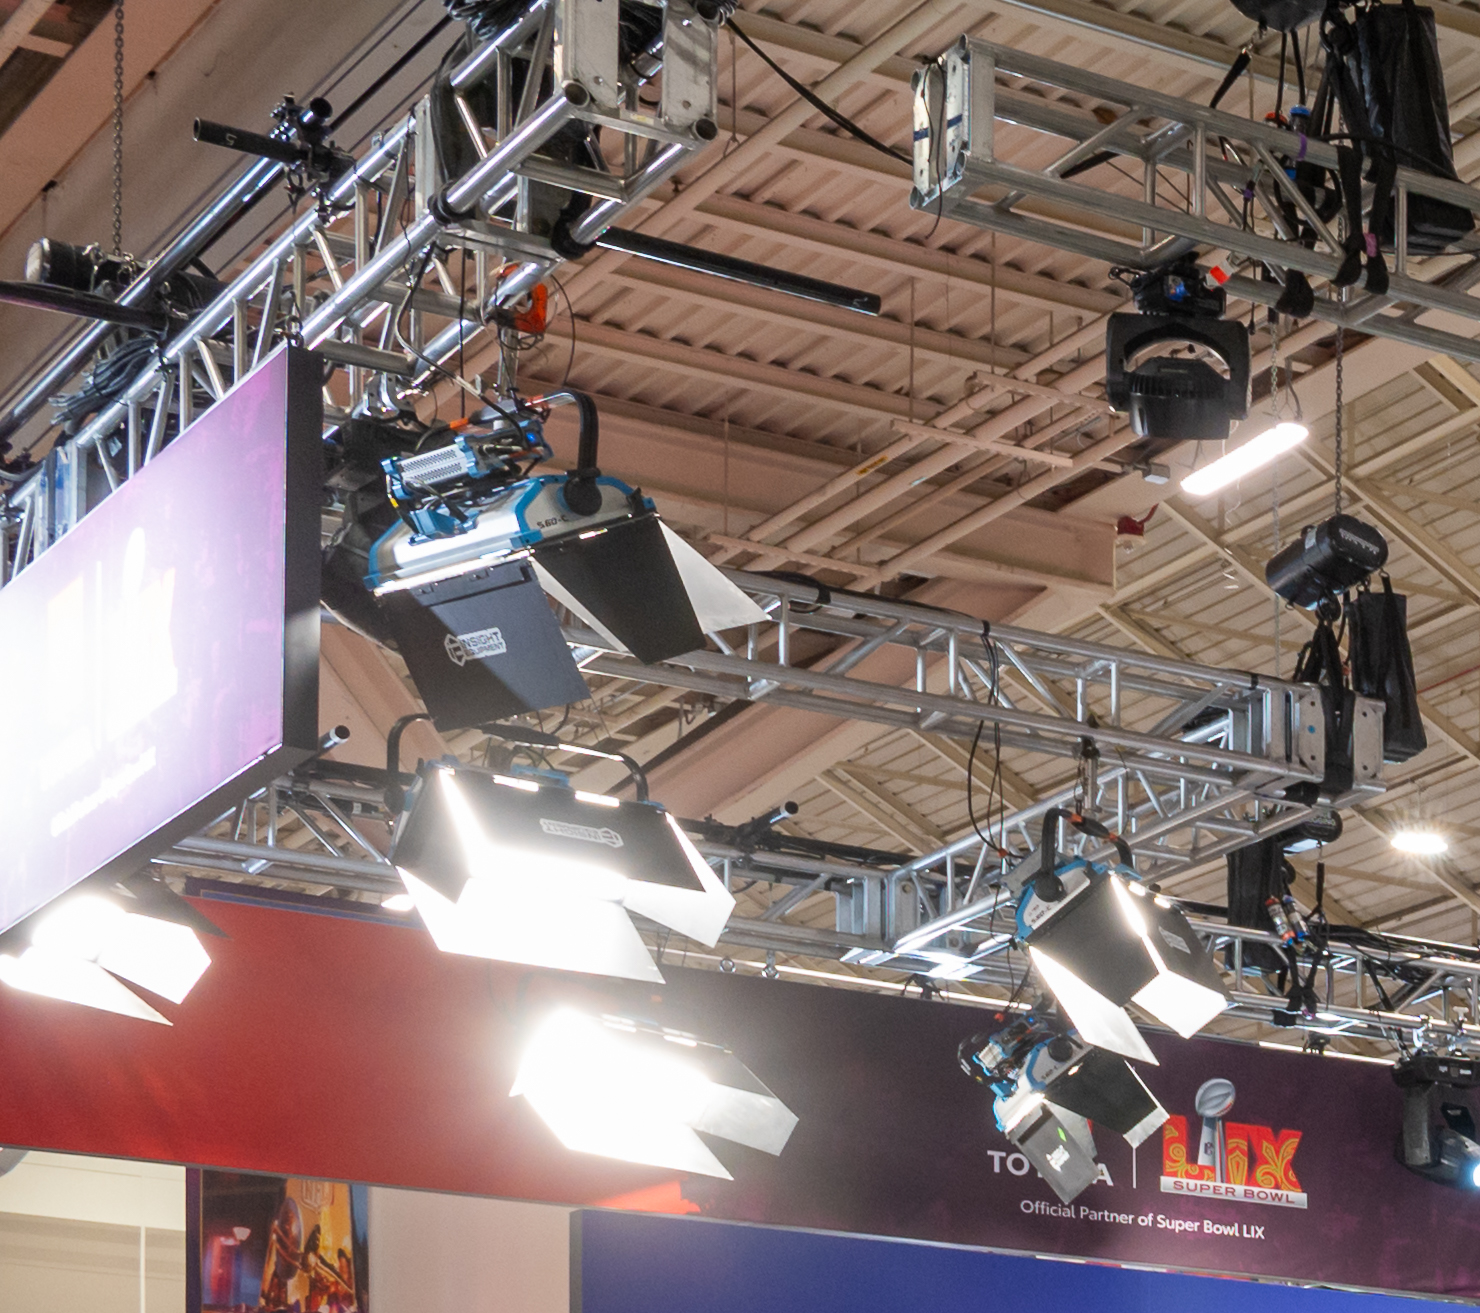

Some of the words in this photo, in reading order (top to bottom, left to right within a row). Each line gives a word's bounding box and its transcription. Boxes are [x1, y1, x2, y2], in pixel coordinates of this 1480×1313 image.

[987, 1150, 1114, 1187] TOA
[1172, 1180, 1237, 1198] SUPER
[1243, 1188, 1297, 1205] BOWL
[1020, 1199, 1076, 1220] Official
[1079, 1205, 1134, 1226] Partner
[1137, 1212, 1155, 1228] of
[1156, 1214, 1201, 1234] Super
[1202, 1219, 1240, 1237] Bowl
[1243, 1224, 1266, 1241] LIX
